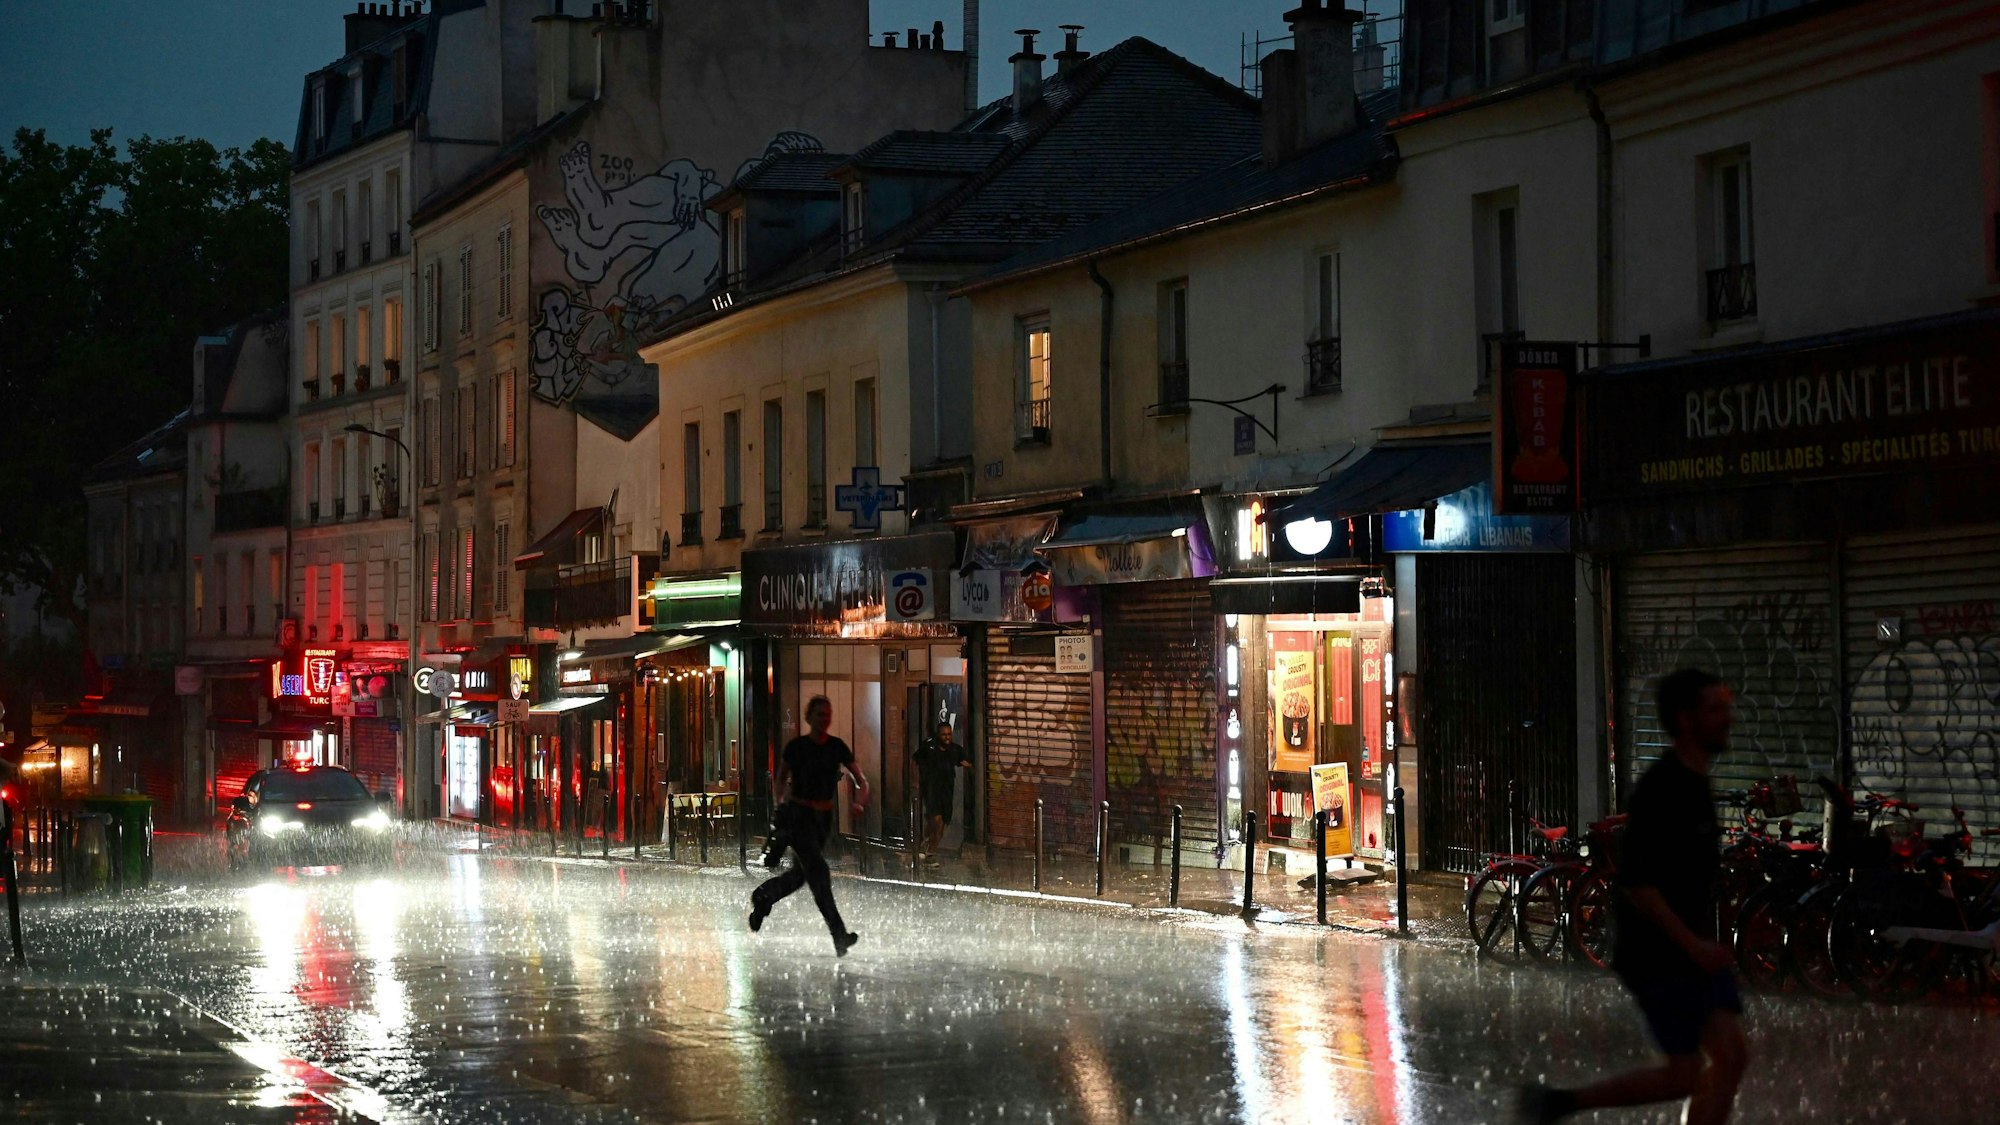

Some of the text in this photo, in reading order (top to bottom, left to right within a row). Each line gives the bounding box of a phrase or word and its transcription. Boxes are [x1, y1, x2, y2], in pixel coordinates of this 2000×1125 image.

[1519, 348, 1558, 364] DÖNER
[1685, 355, 1972, 439] RESTAURANT ELITE
[1532, 378, 1546, 447] KEBAB
[1641, 454, 1724, 484] SANDWICHS
[1740, 445, 1824, 474] GRILLADES
[1479, 526, 1533, 546] LIBANAIS
[759, 571, 823, 611] CLINIQUE
[962, 577, 983, 605] Lyca
[1025, 579, 1050, 598] ria
[309, 697, 330, 705] TURC
